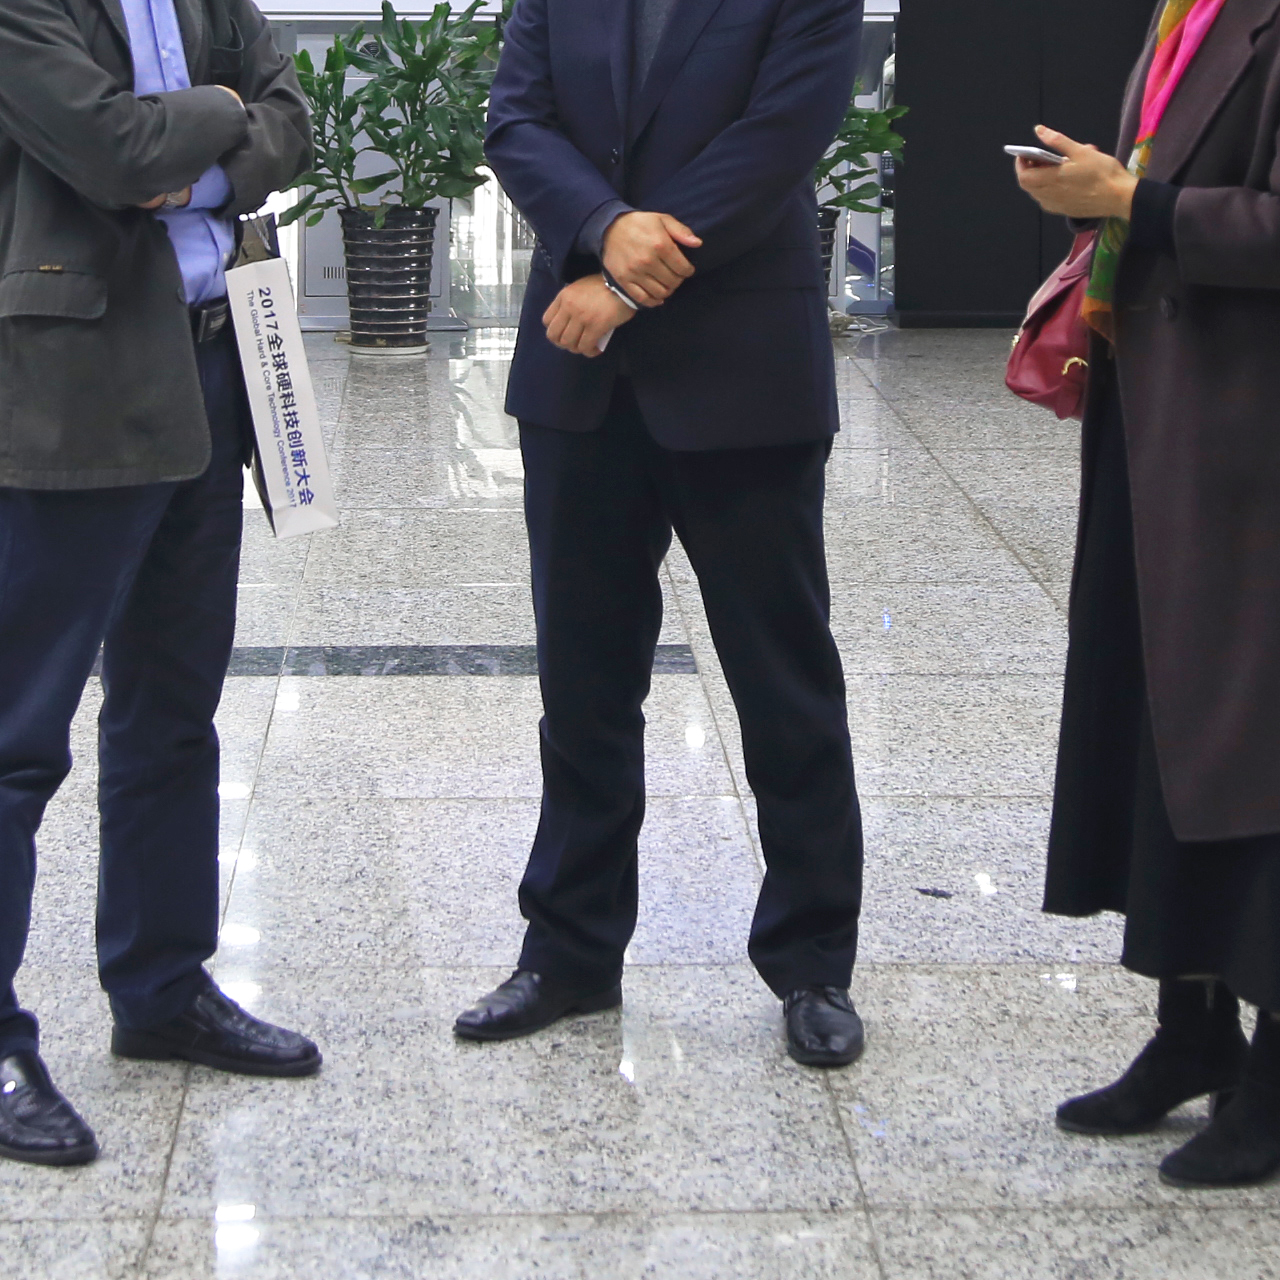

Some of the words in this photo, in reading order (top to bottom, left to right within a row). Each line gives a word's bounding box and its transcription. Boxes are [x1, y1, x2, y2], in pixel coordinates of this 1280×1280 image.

[246, 291, 255, 307] The
[250, 309, 261, 337] Global
[256, 336, 266, 359] Hard
[262, 370, 272, 391] Core
[258, 286, 315, 506] 2017全球硬科技创新大会
[267, 393, 281, 438] Technology
[276, 440, 291, 487] Conference
[286, 488, 297, 508] 2017
